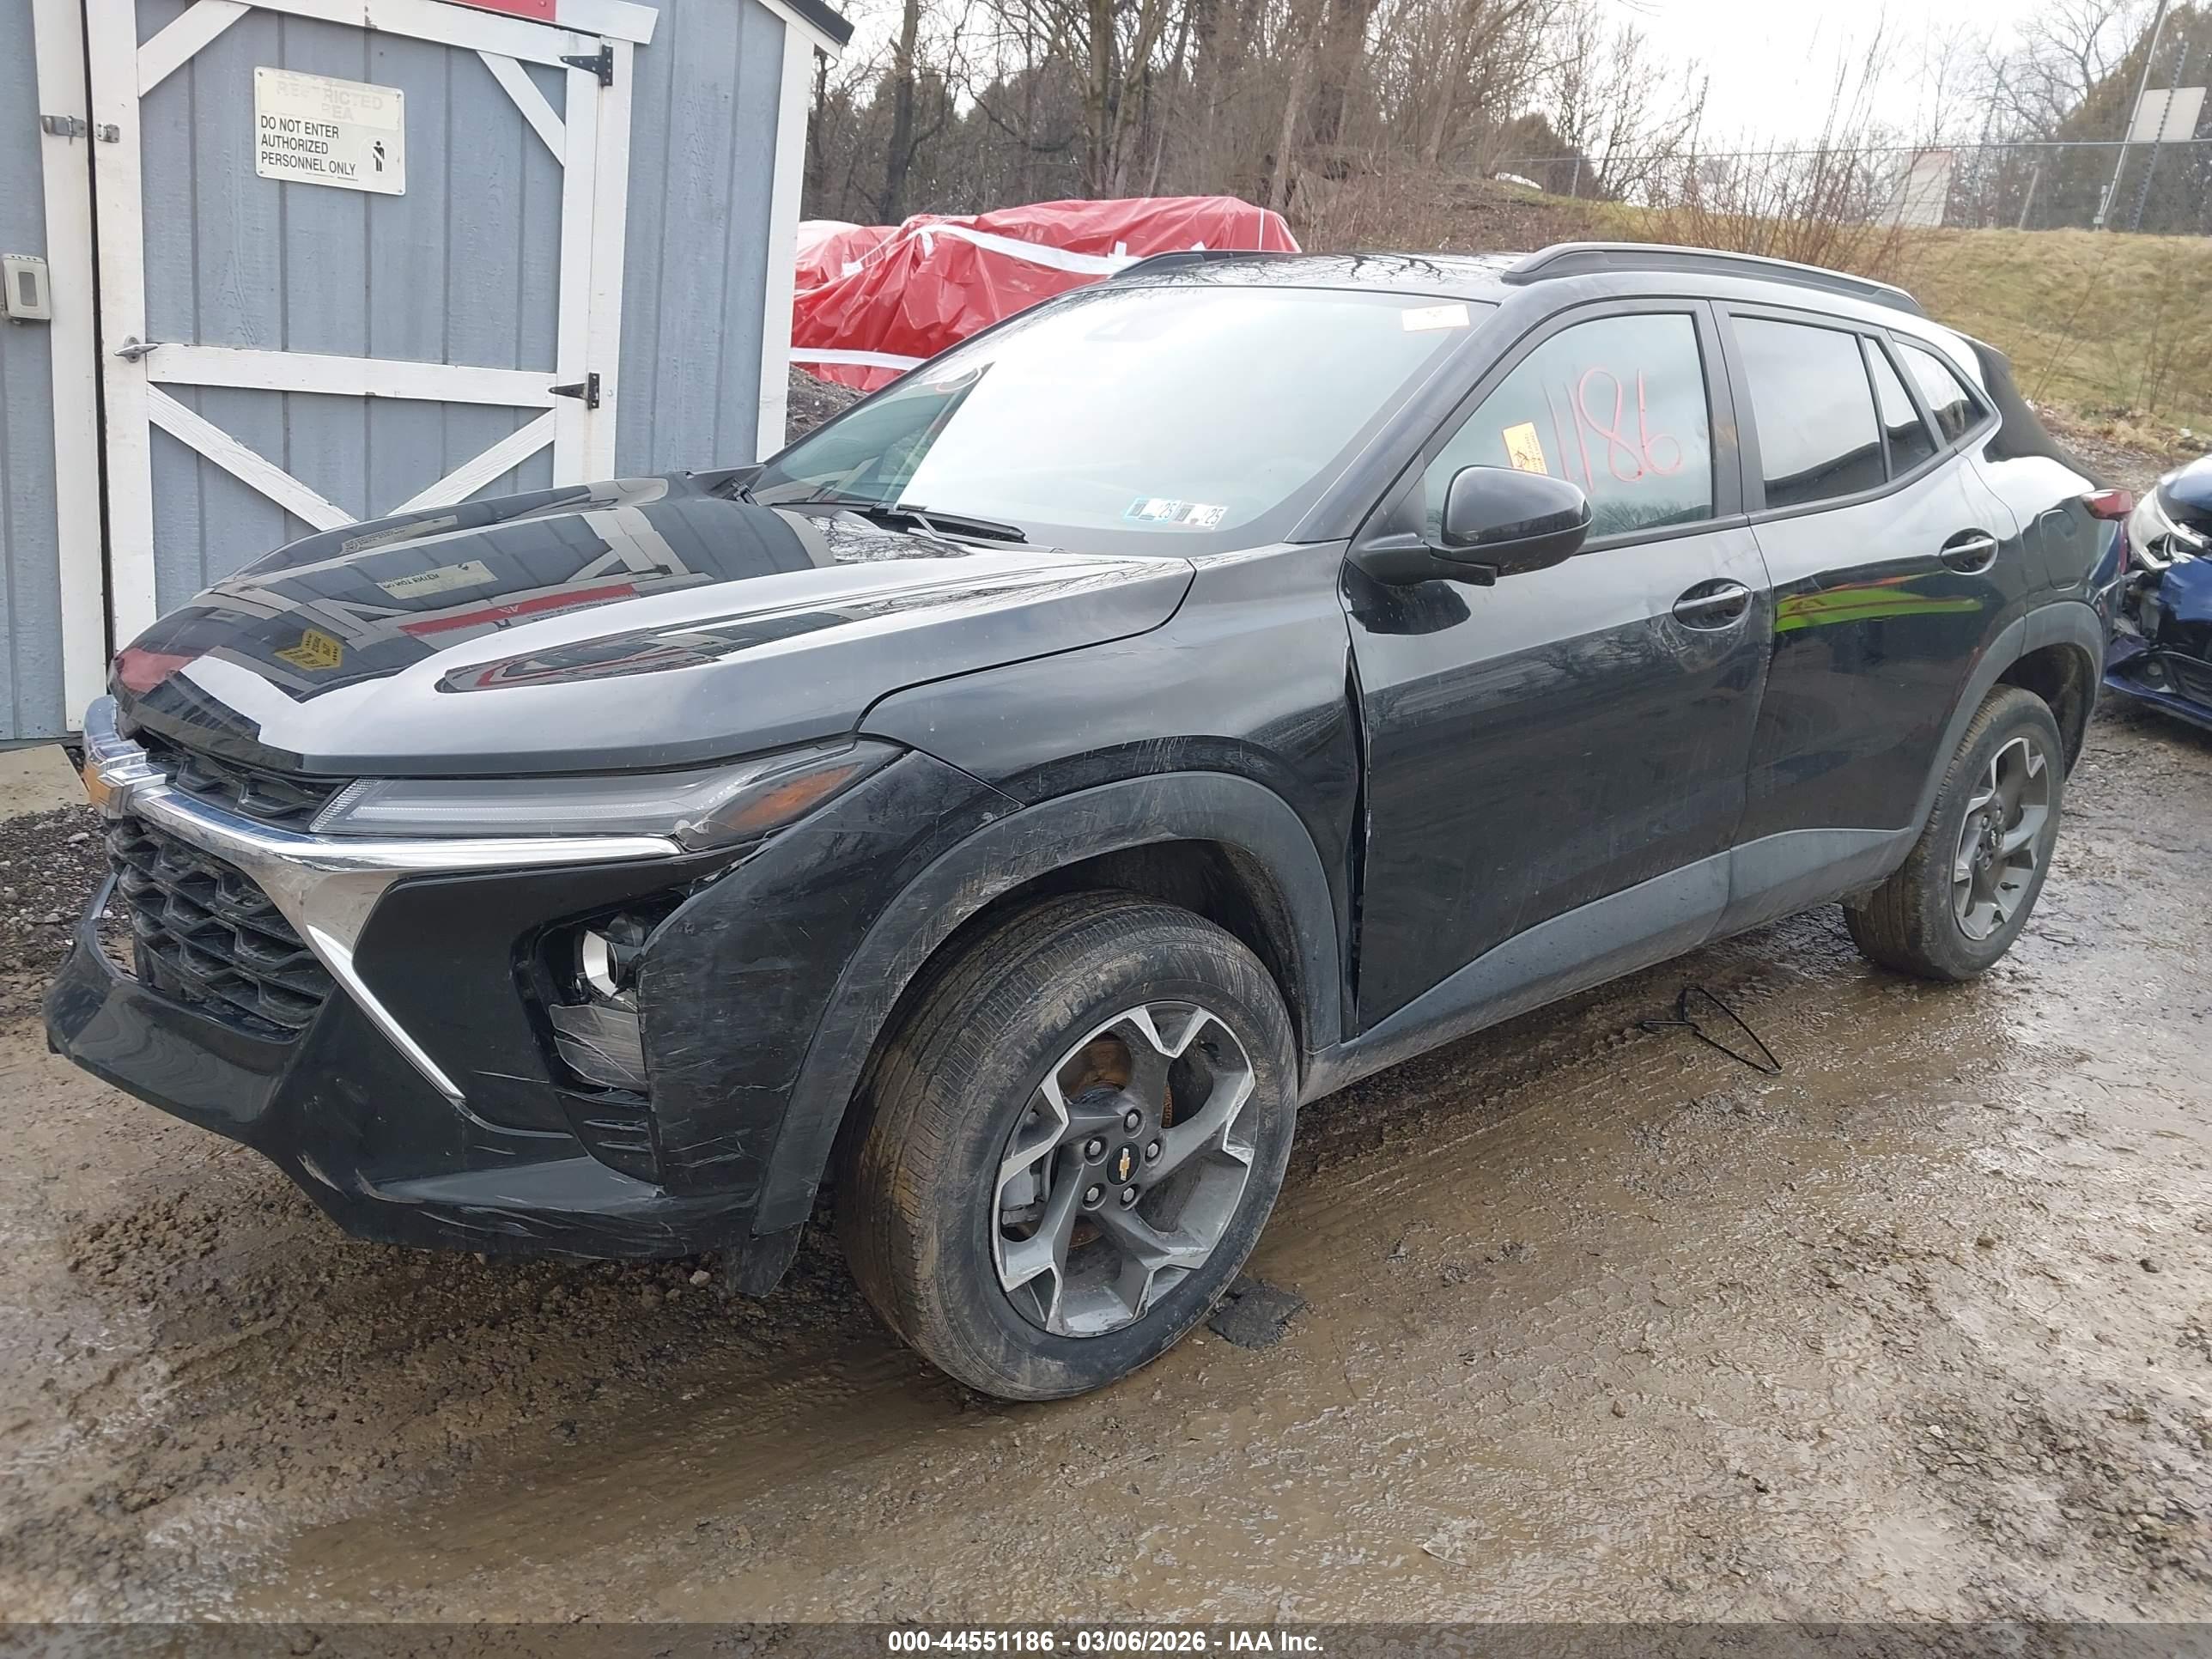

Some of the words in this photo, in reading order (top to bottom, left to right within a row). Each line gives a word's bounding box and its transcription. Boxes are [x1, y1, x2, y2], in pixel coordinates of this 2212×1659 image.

[261, 115, 276, 130] DO
[279, 118, 301, 133] NOT
[305, 122, 339, 138] ENTER
[261, 134, 329, 155] AUTHORIZED
[261, 151, 326, 172] PERSONNEL
[329, 161, 356, 176] ONLY
[1541, 367, 1682, 493] 1186
[1205, 508, 1224, 525] 25
